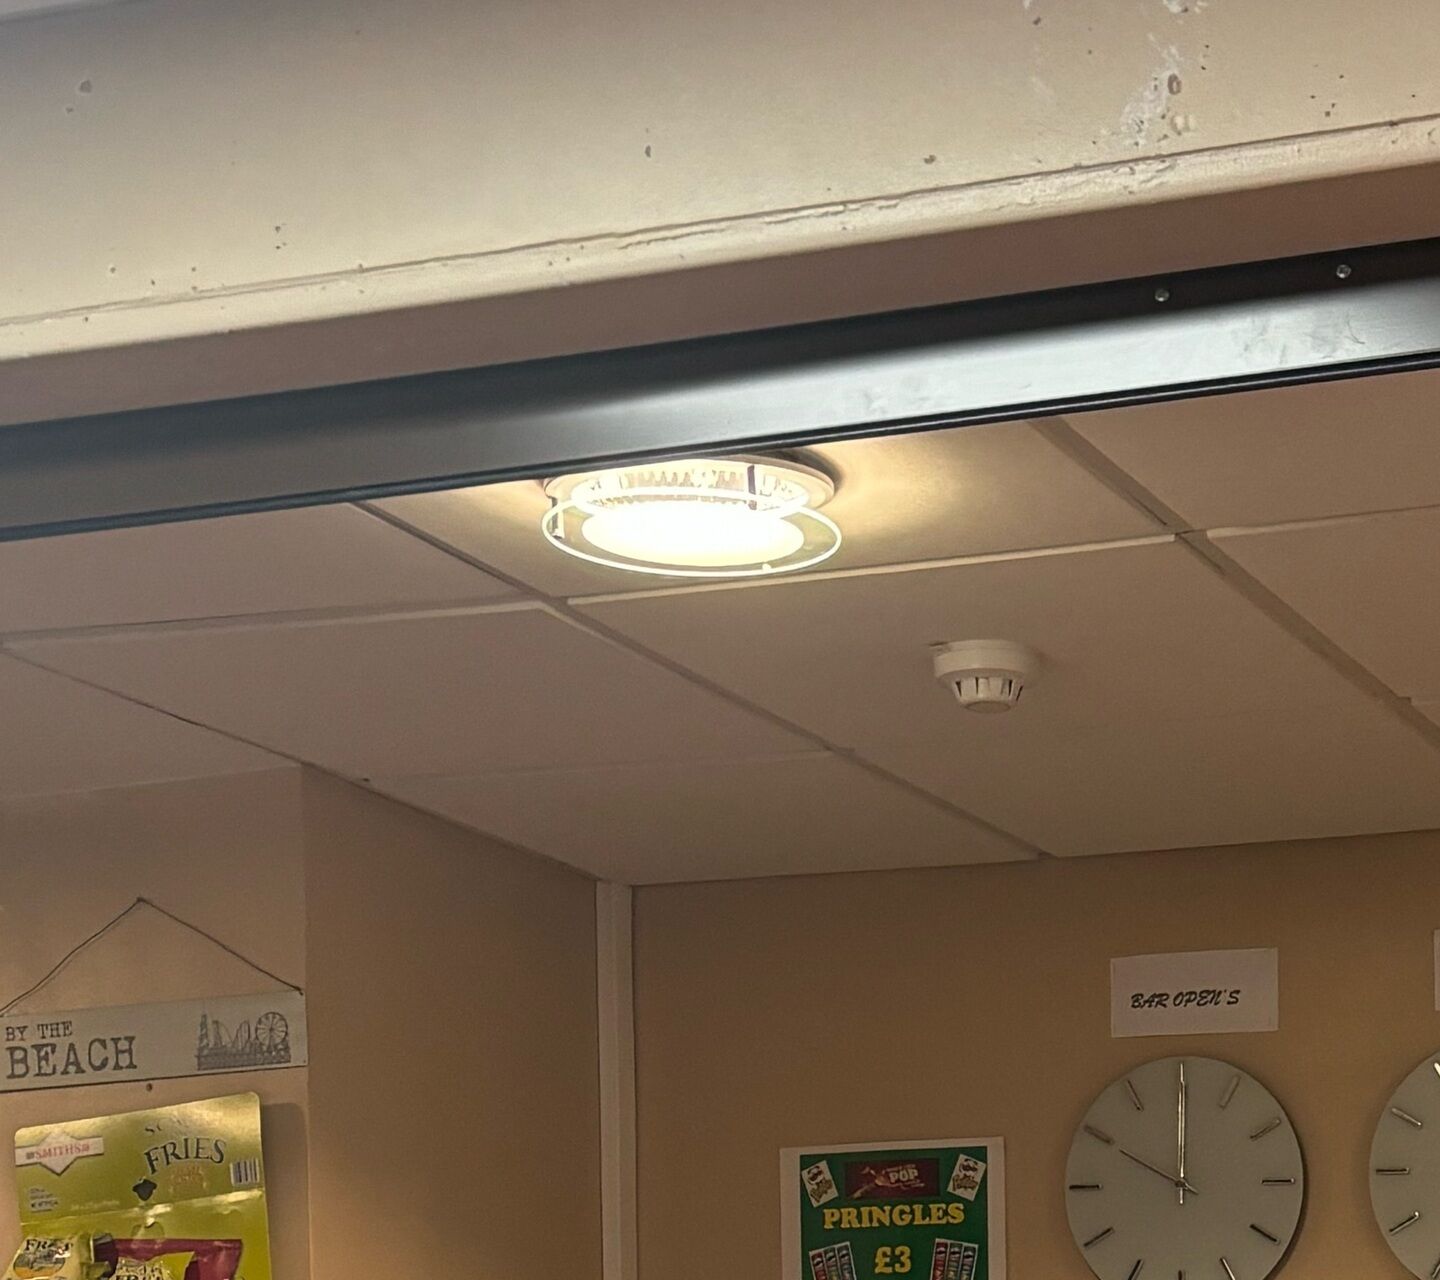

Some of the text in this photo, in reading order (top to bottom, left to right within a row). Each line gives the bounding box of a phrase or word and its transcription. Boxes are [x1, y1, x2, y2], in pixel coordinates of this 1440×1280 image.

[1130, 989, 1241, 1009] BAR OPEN'S
[5, 1020, 73, 1041] BY THE
[5, 1036, 138, 1079] BEACH
[144, 1137, 227, 1175] FRIES
[823, 1203, 965, 1229] PRINGLES
[874, 1246, 911, 1274] £3
